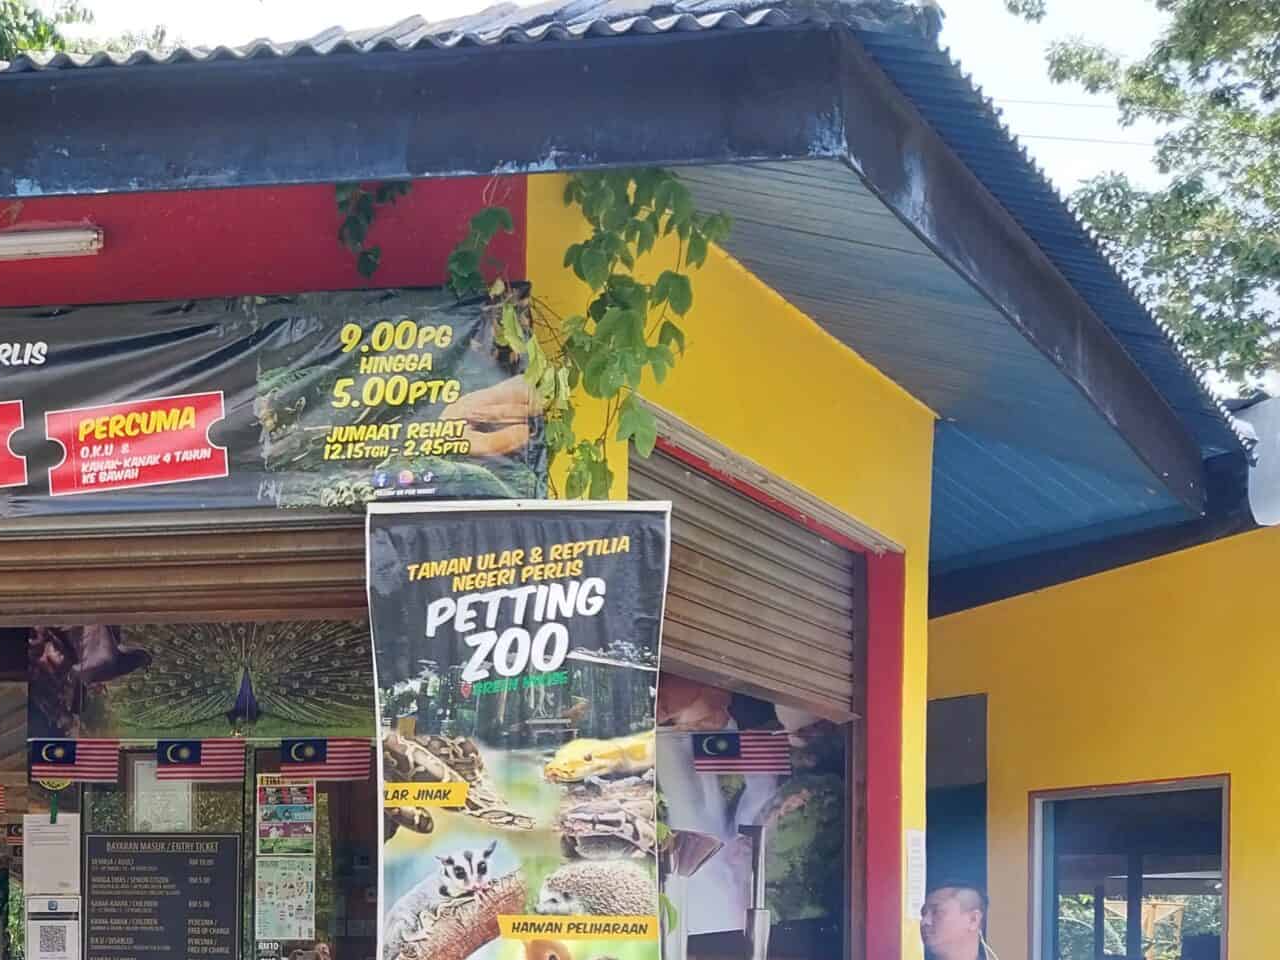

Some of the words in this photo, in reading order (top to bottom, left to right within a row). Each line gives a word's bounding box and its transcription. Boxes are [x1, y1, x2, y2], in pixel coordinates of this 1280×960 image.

[339, 320, 453, 353] 9.00PG
[359, 353, 433, 374] HINGGA
[331, 375, 461, 408] 5.00PTG
[78, 406, 197, 442] PERCUMA
[326, 423, 403, 443] JUMAAT
[407, 420, 468, 440] REHAT
[80, 456, 161, 474] KANAK-KANAK
[163, 452, 171, 465] 4
[173, 447, 212, 462] TAHUN
[403, 439, 470, 457] 2.45PTG
[81, 472, 97, 485] KE
[99, 468, 139, 483] BAWAH
[407, 556, 472, 581] TAMAN
[478, 549, 524, 570] ULAR
[529, 546, 543, 563] &
[549, 536, 631, 561] REPTILIA
[452, 569, 516, 592] NEGERI
[521, 559, 583, 582] PERLIS
[425, 577, 606, 637] PETTING
[461, 622, 569, 681] ZOO
[384, 789, 409, 801] LAR
[413, 789, 452, 801] JINAK
[512, 922, 563, 933] HAIWAN
[566, 922, 649, 935] PELIHARAAN
